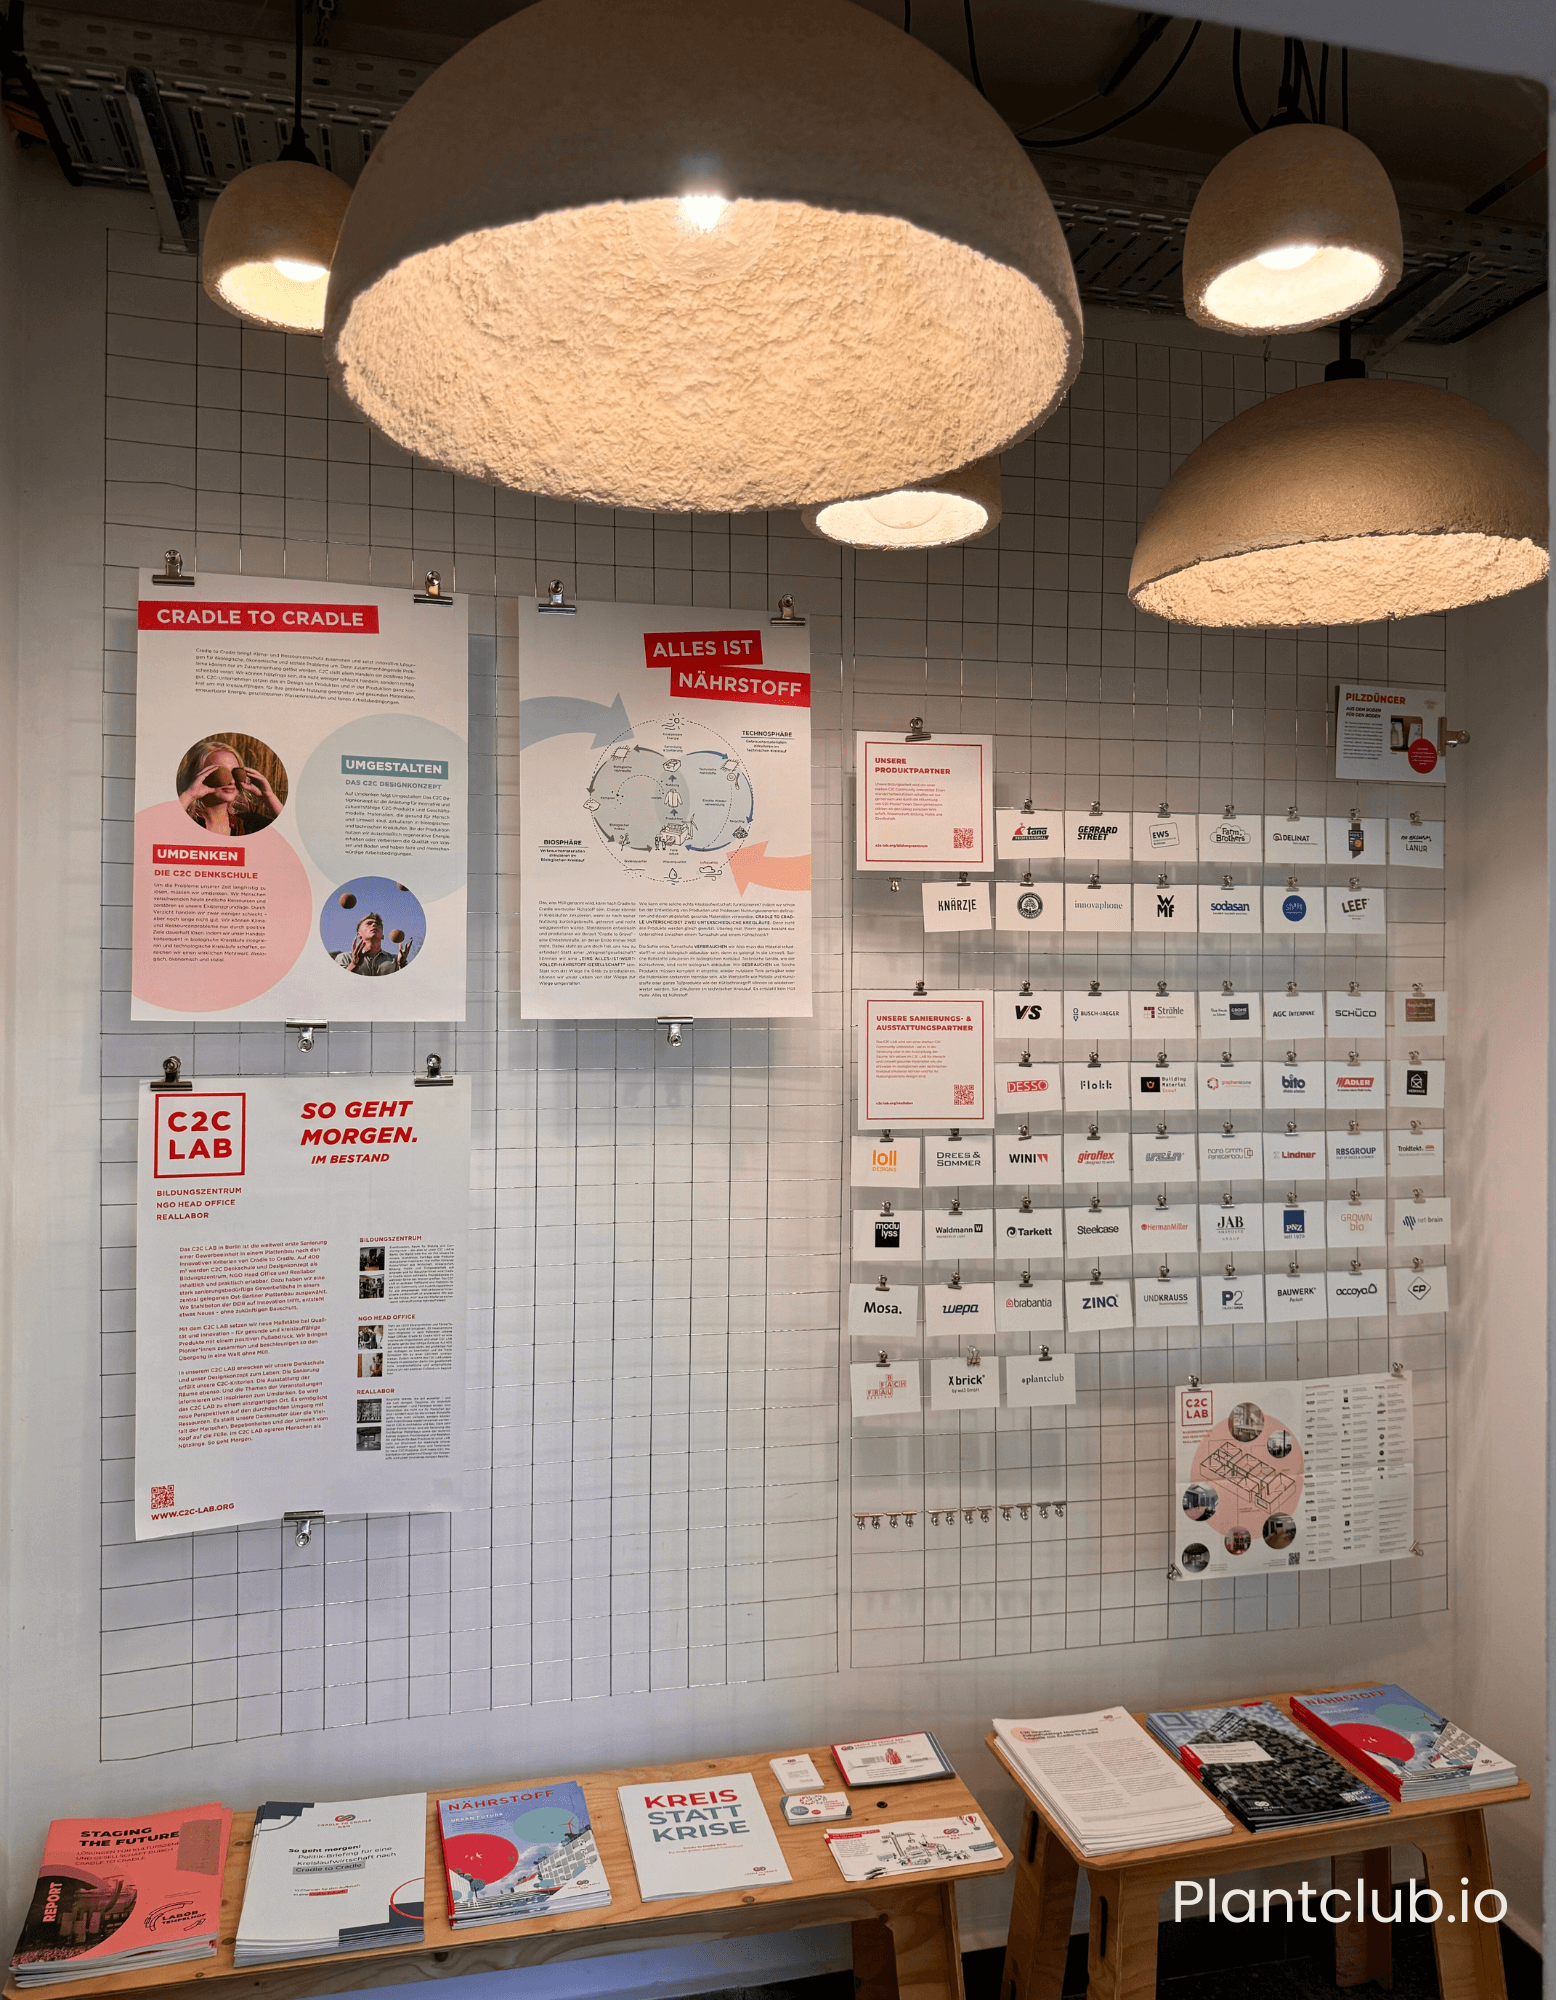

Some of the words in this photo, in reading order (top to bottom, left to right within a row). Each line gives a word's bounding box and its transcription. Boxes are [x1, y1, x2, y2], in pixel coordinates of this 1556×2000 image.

[157, 608, 241, 626] CRADLE
[248, 610, 275, 626] TO
[282, 610, 364, 627] CRADLE
[653, 641, 717, 657] ALLES
[723, 640, 753, 655] IST
[679, 667, 802, 696] NÄHRSTOFF
[1346, 693, 1405, 704] PILZDÜNGER
[346, 759, 442, 774] UMGESTALTEN
[380, 781, 442, 789] DESIGNKONZEPT
[1027, 827, 1047, 835] tana
[1216, 834, 1245, 842] Brothers
[1406, 844, 1427, 852] LANUR
[157, 849, 238, 861] UMDENKEN
[195, 871, 258, 879] DENKSCHULE
[938, 898, 976, 912] KNÄRZJE
[1075, 900, 1123, 910] innovaphone
[1211, 901, 1250, 912] sodasan
[1342, 899, 1367, 913] LEEF
[1335, 1008, 1376, 1017] SCHÜCO
[1007, 1080, 1048, 1093] DESSO
[1282, 1074, 1305, 1089] bito
[300, 1102, 336, 1119] SO
[344, 1101, 414, 1118] GEHT
[168, 1110, 231, 1132] C2C
[300, 1127, 418, 1146] MORGEN.
[169, 1138, 232, 1159] LAB
[1336, 1147, 1376, 1155] RBSGROUP
[311, 1155, 326, 1164] IM
[330, 1154, 390, 1164] BESTAND
[872, 1150, 897, 1166] loll
[1009, 1154, 1036, 1163] WINI
[1078, 1150, 1115, 1164] giroflex
[156, 1187, 242, 1196] BILDUNGSZENTRUM
[178, 1200, 201, 1208] HEAD
[204, 1199, 236, 1207] OFFICE
[156, 1212, 209, 1221] REALLABOR
[1218, 1215, 1243, 1228] JAB
[1018, 1227, 1052, 1236] Tarkett
[1077, 1224, 1119, 1235] Steelcase
[1148, 1223, 1188, 1232] HermanMiller
[1286, 1224, 1303, 1232] PNZ
[1350, 1222, 1364, 1231] bio
[882, 1229, 898, 1238] lyss
[1222, 1290, 1243, 1305] P2
[1277, 1288, 1314, 1296] BAUWERK
[1336, 1287, 1368, 1298] accoya
[1014, 1298, 1052, 1308] brabantia
[1143, 1294, 1188, 1302] UNDKRAUSS
[864, 1302, 902, 1314] Mosa.
[942, 1304, 979, 1315] wepa
[1186, 1398, 1207, 1407] C2C
[1187, 1410, 1208, 1418] LAB
[151, 1503, 235, 1521] WWW.C2C-LAB.ORG
[1305, 1690, 1385, 1706] NÄHRSTOFF
[449, 1790, 554, 1811] NÄHRSTOFF
[644, 1789, 738, 1808] KREIS
[648, 1804, 742, 1825] STATT
[81, 1827, 152, 1837] STAGING
[653, 1820, 750, 1842] KRISE
[116, 1831, 179, 1845] FUTURE
[93, 1852, 146, 1860] GESELLSCHAFT
[297, 1854, 373, 1866] Kreislaufwirtschaft
[298, 1851, 358, 1859] Politik-Briefing
[43, 1882, 63, 1922] REPORT
[162, 1911, 198, 1920] LABOR
[162, 1913, 206, 1924] TEMPELHOF
